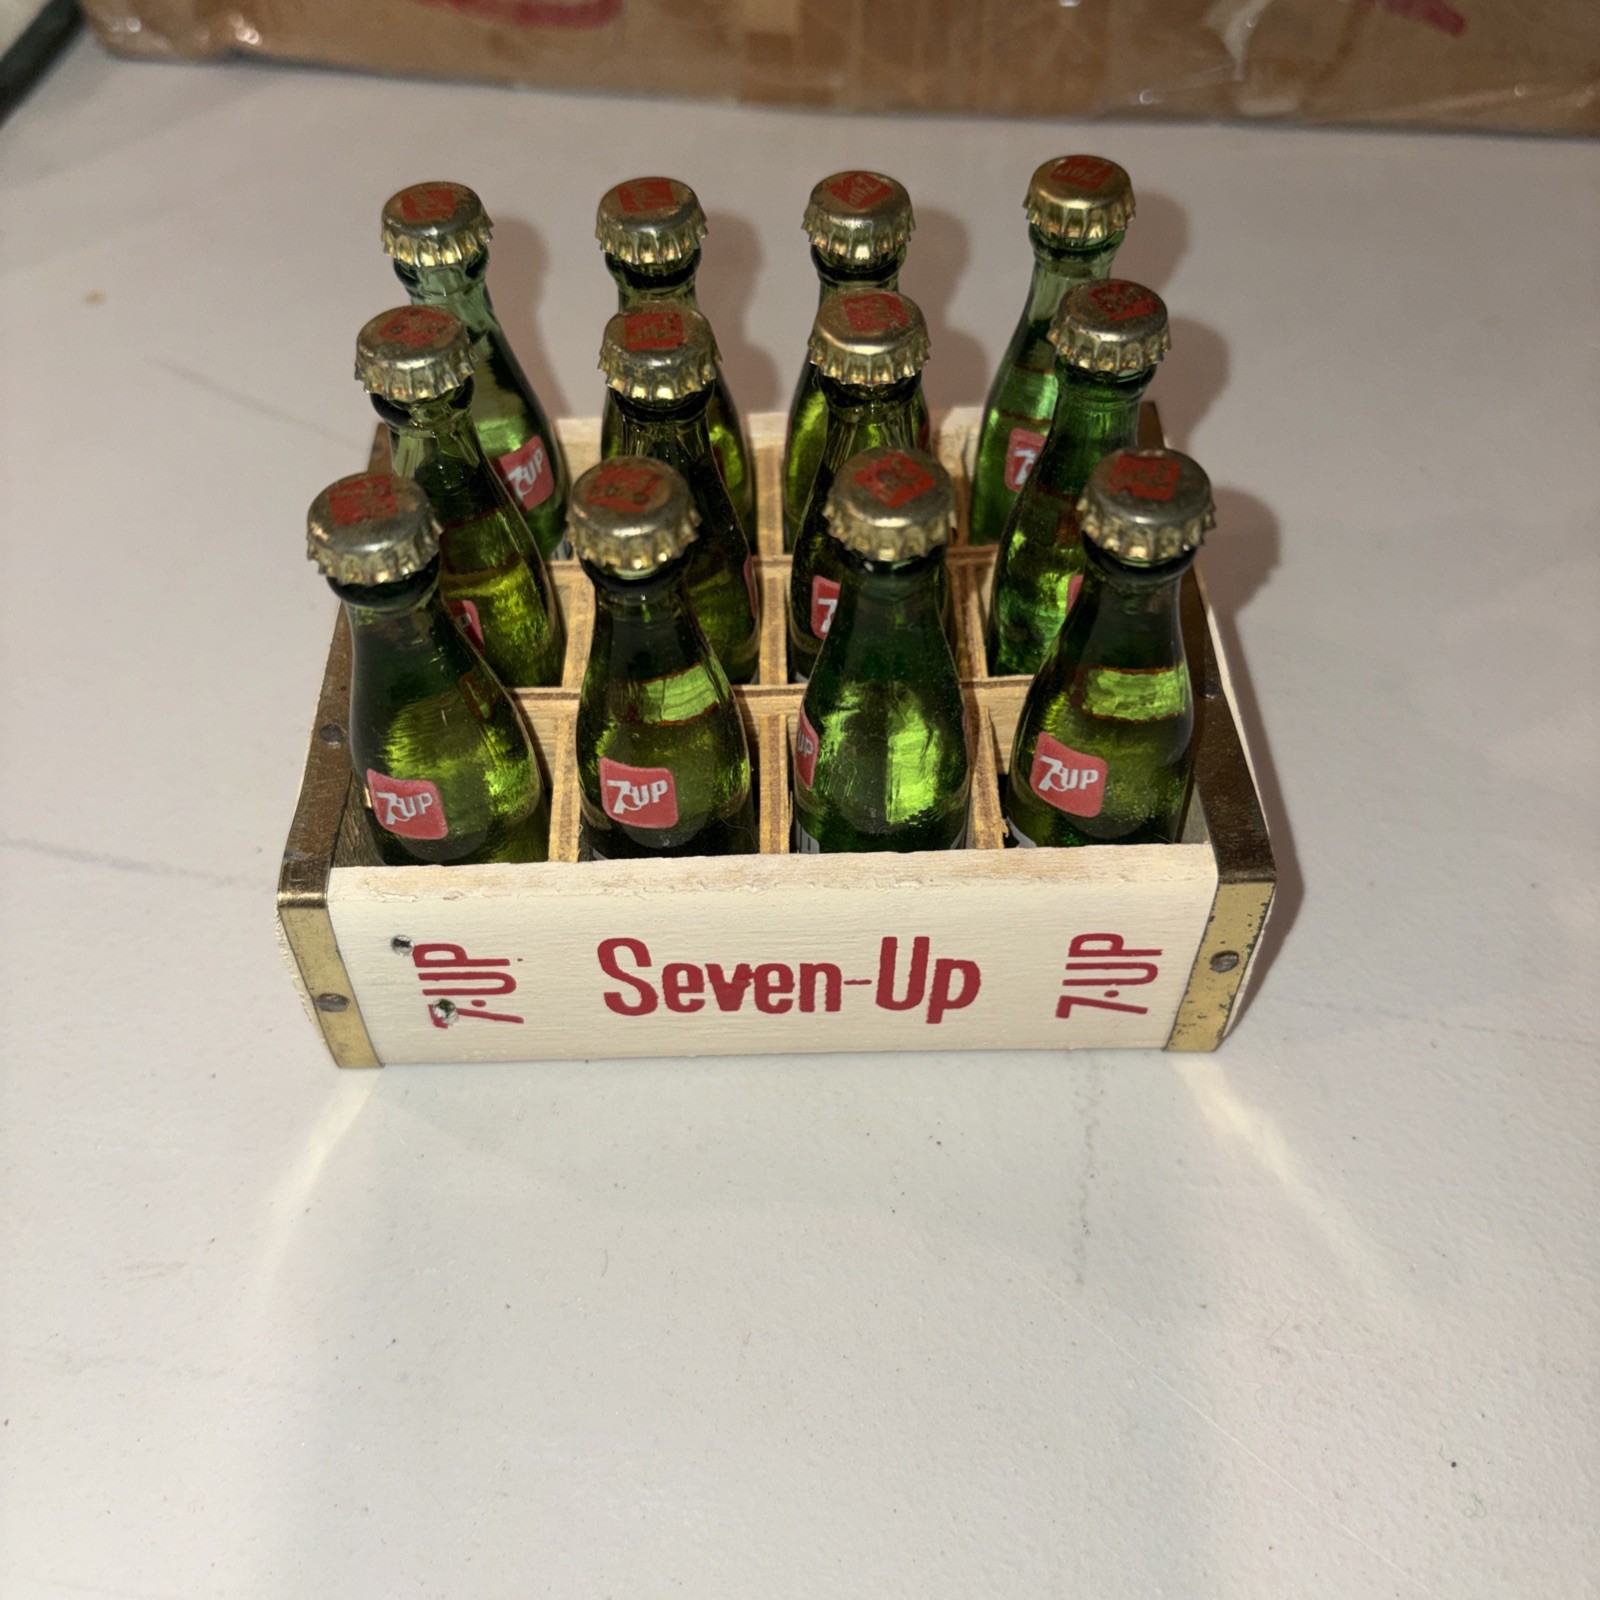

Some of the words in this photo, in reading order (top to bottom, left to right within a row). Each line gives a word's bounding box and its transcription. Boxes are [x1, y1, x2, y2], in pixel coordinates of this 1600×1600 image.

[507, 448, 543, 501] 7UP
[1038, 755, 1099, 792] 7UP
[375, 791, 433, 825] 7UP
[606, 779, 668, 814] 7UP
[597, 936, 981, 1024] Seven-Up
